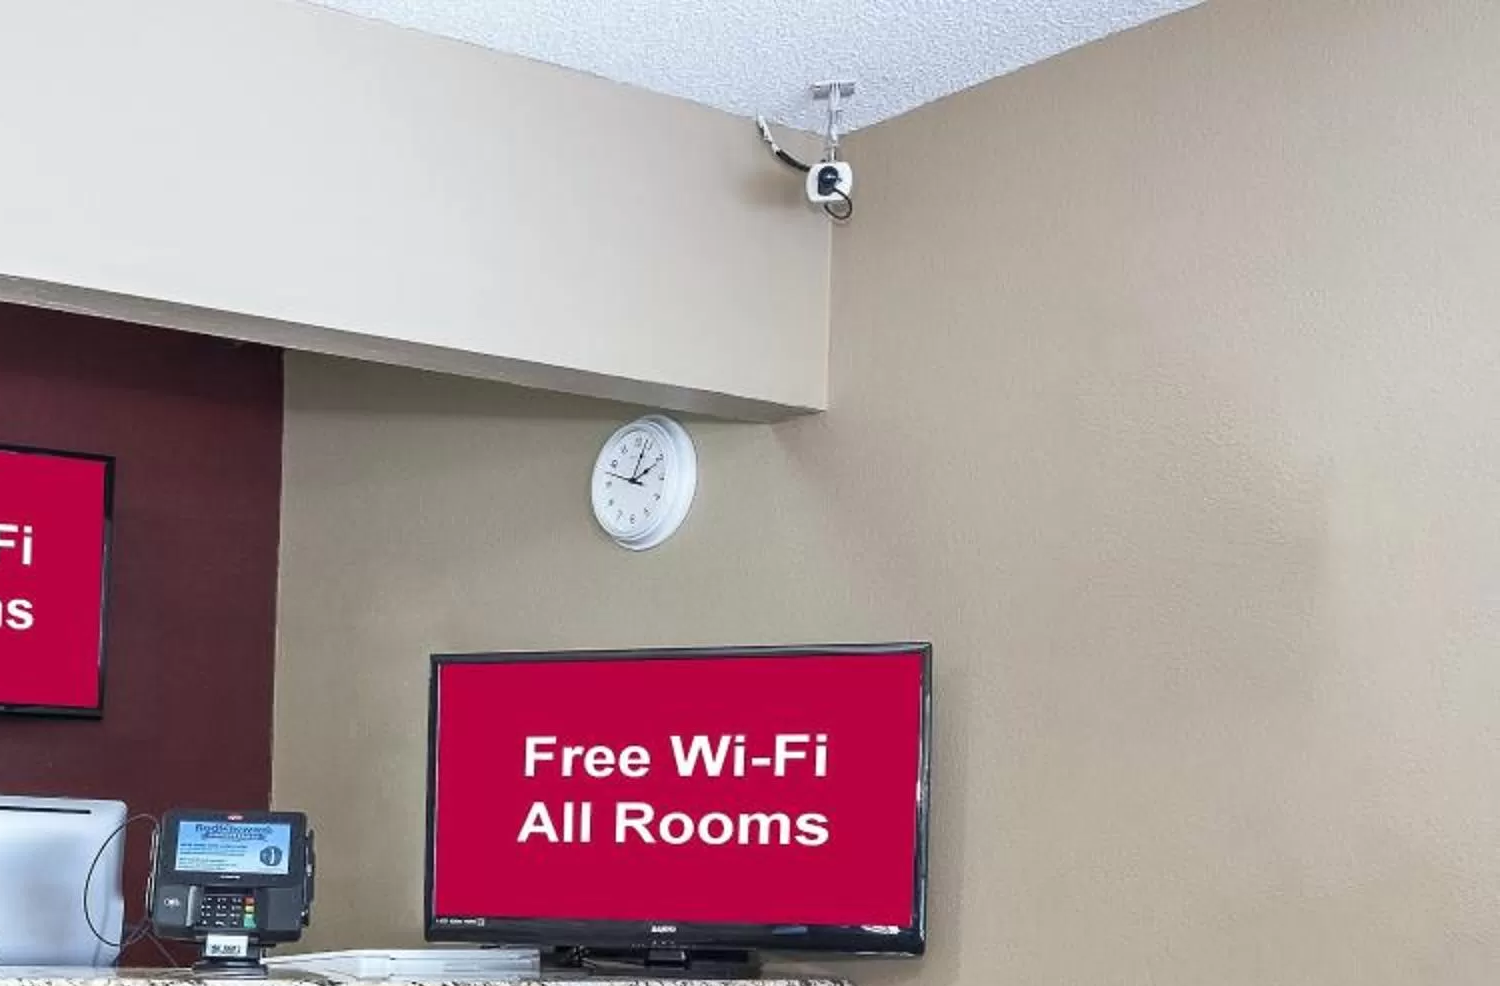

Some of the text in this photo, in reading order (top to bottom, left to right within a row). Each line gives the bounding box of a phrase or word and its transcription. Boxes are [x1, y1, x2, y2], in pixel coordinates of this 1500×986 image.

[524, 733, 828, 778] Free Wi-Fi
[517, 801, 830, 847] All Rooms
